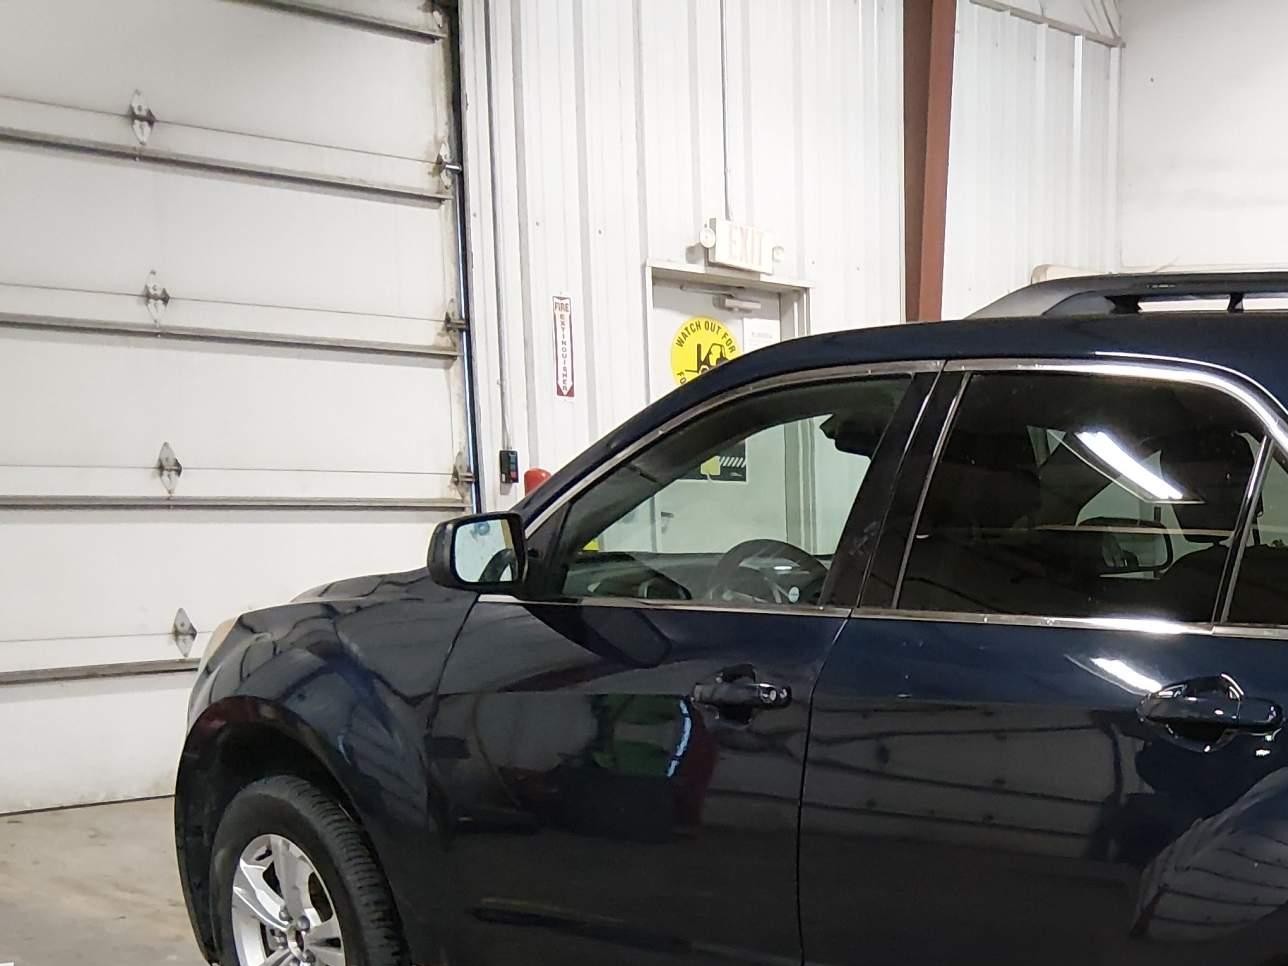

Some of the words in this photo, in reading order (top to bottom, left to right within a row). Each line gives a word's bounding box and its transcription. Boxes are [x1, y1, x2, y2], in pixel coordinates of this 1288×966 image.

[728, 225, 766, 266] EXIT
[554, 301, 569, 312] FIRE
[560, 313, 568, 391] EXTINGUISHER
[675, 319, 702, 348] WATCH
[704, 320, 721, 335] OUT
[721, 332, 736, 353] FOR
